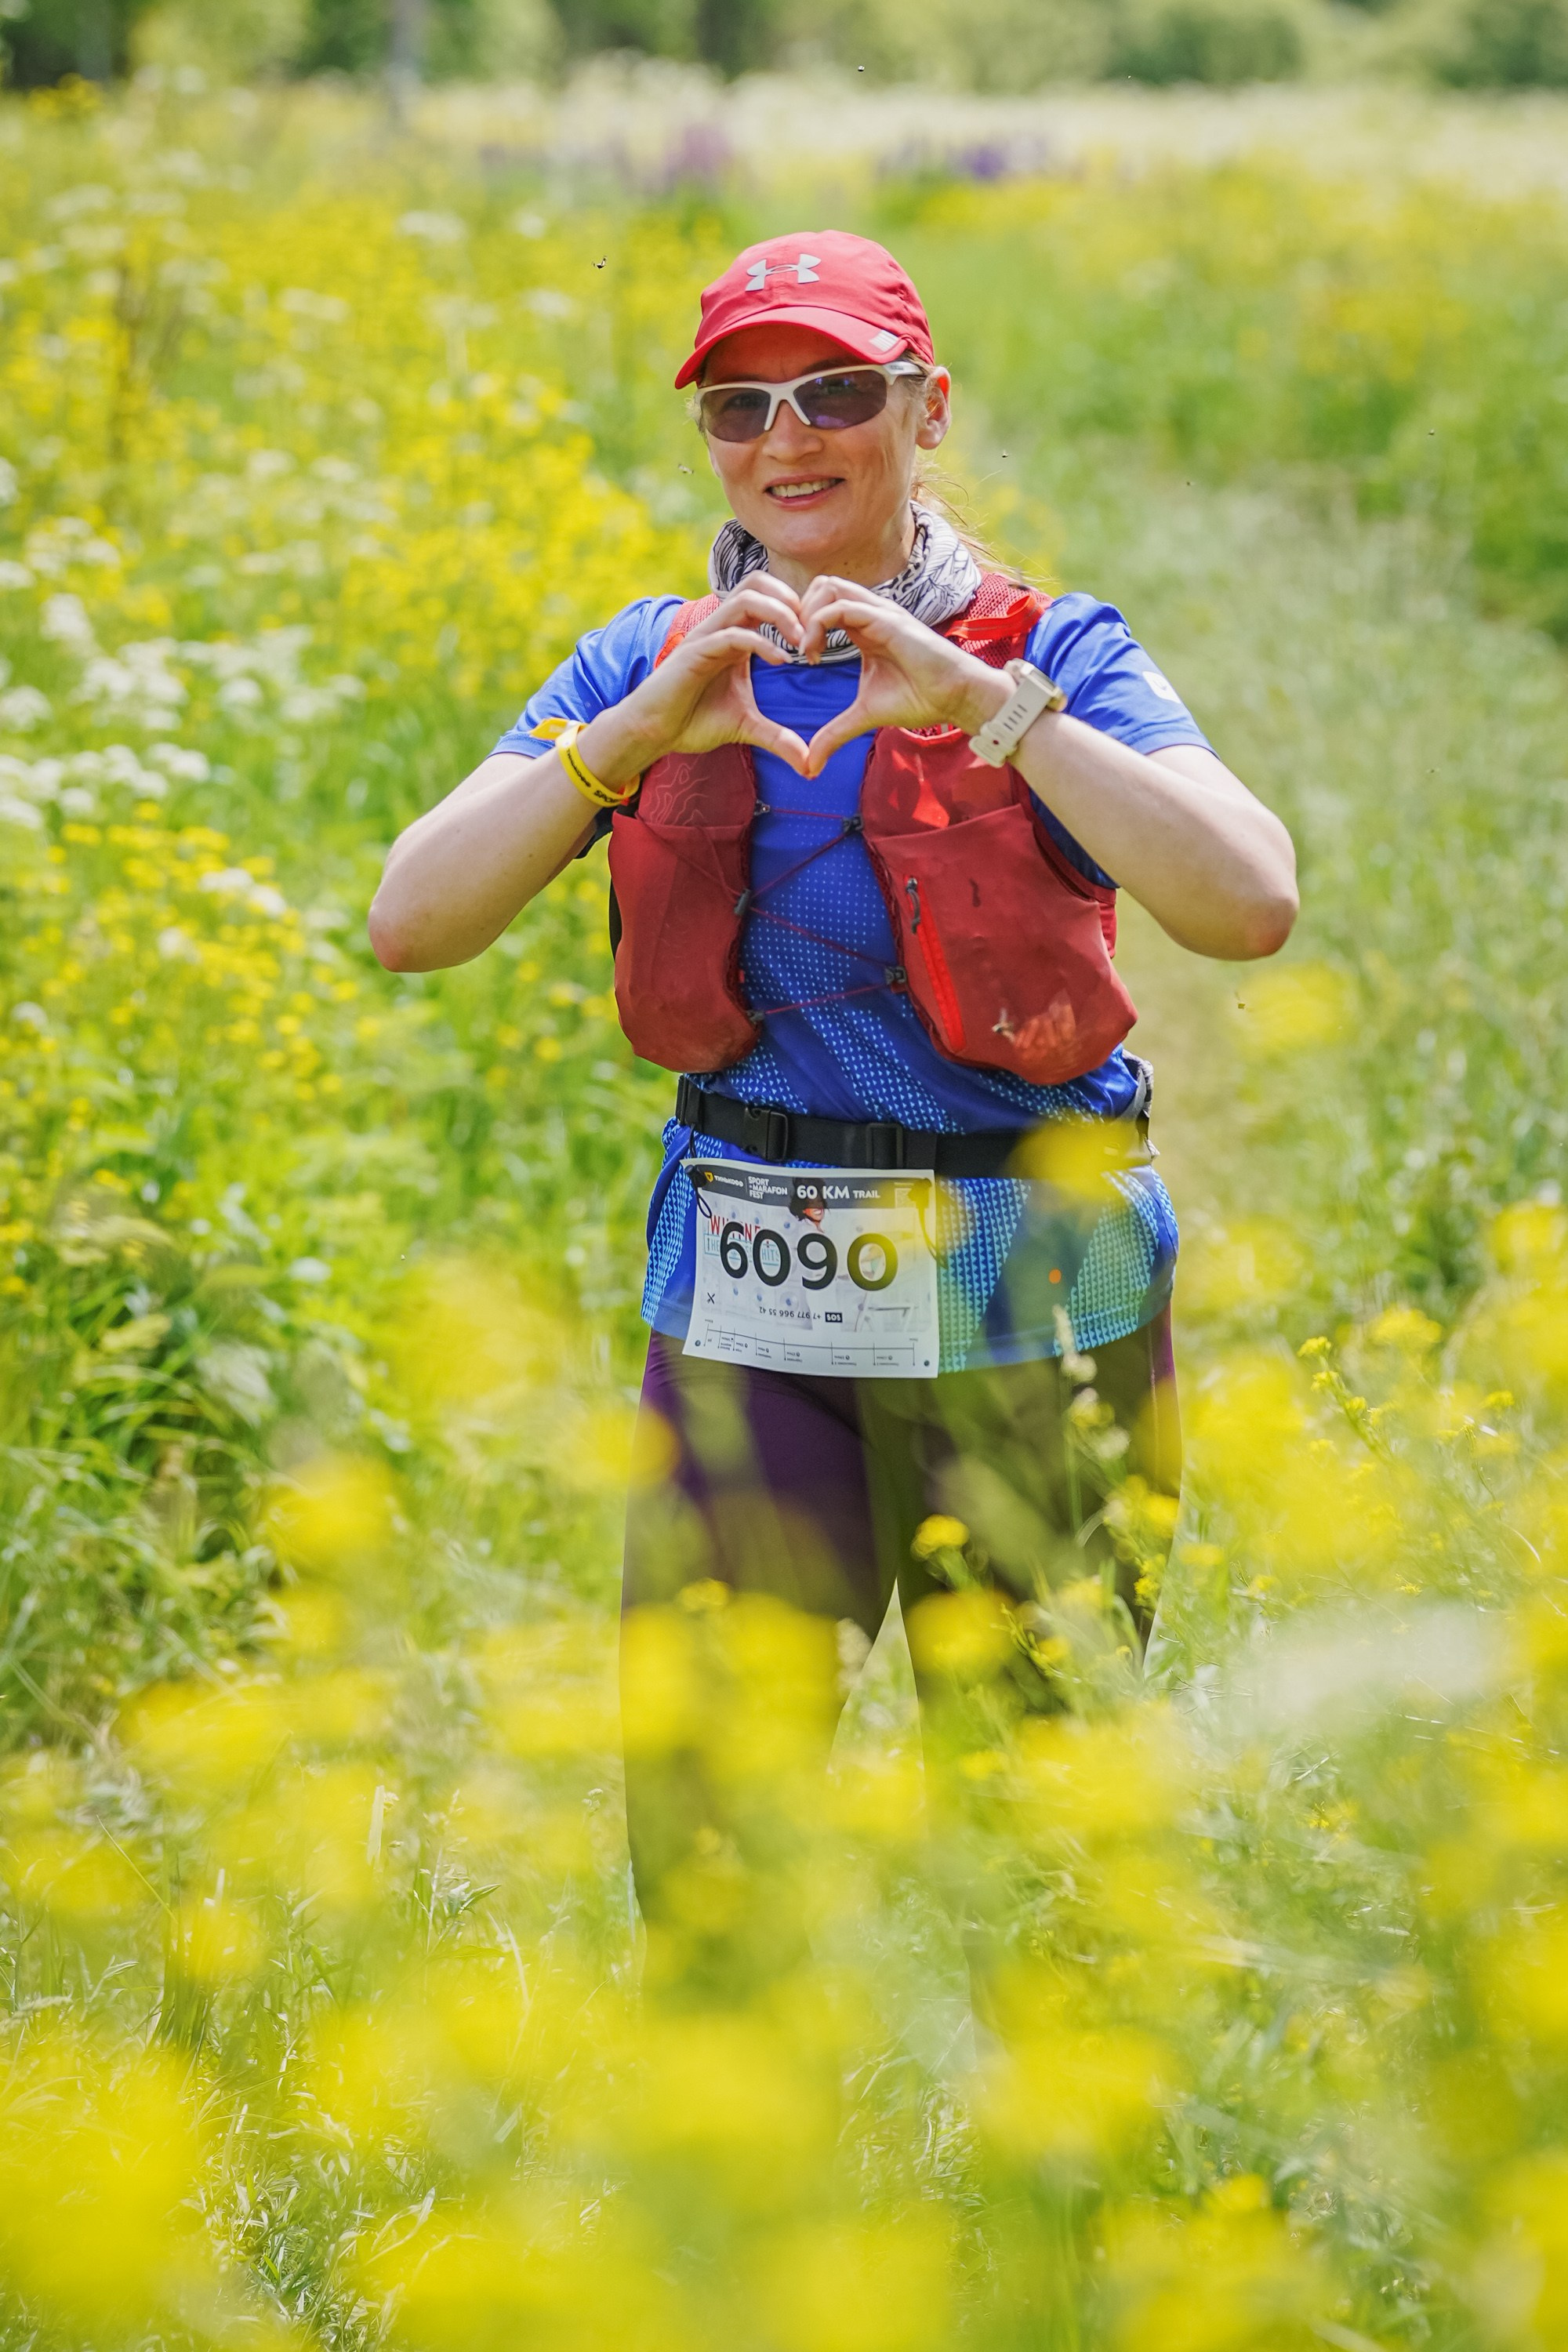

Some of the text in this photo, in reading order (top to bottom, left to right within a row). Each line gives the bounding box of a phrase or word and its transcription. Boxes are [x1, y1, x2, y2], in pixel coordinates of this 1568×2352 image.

[748, 1176, 769, 1186] SPORT
[749, 1191, 764, 1200] FEST
[797, 1185, 880, 1200] 60 KM TRAIL
[720, 1221, 898, 1291] 6090
[779, 1309, 794, 1318] 966
